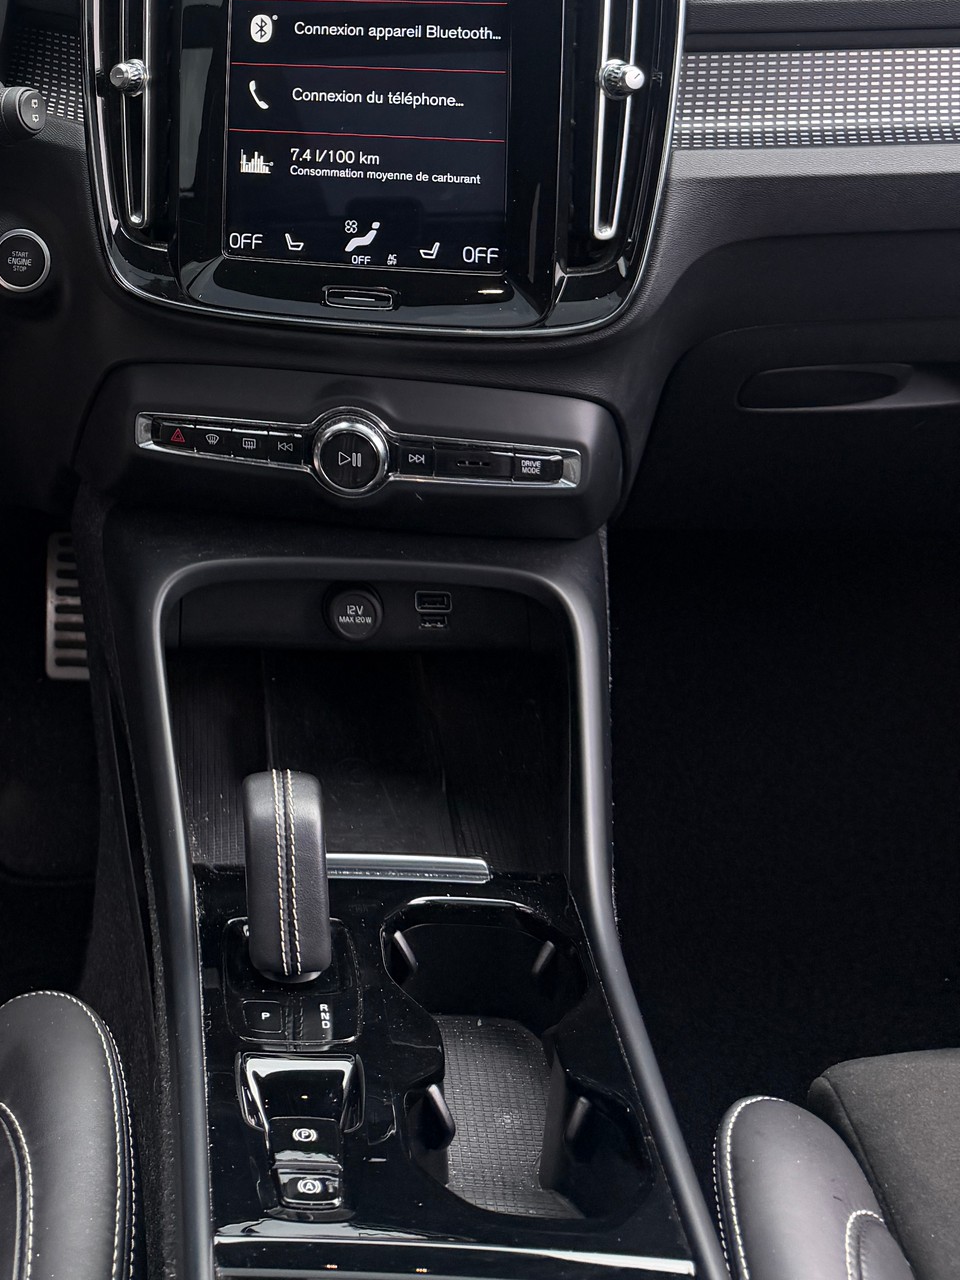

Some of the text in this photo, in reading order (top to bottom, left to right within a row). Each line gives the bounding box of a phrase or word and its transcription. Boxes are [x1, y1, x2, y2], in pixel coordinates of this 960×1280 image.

[294, 21, 364, 36] Connexion
[368, 24, 422, 41] appareil
[292, 87, 362, 104] Connexion
[366, 91, 384, 105] du
[290, 148, 312, 162] 7.4
[359, 151, 381, 165] km
[290, 165, 481, 185] Consommation moyenne de carburant
[229, 232, 263, 250] OFF
[7, 257, 32, 266] ENGINE
[351, 255, 371, 265] OFF
[462, 246, 499, 264] OFF
[521, 460, 541, 468] DRIVE
[521, 467, 541, 475] MODE
[261, 1012, 270, 1020] P
